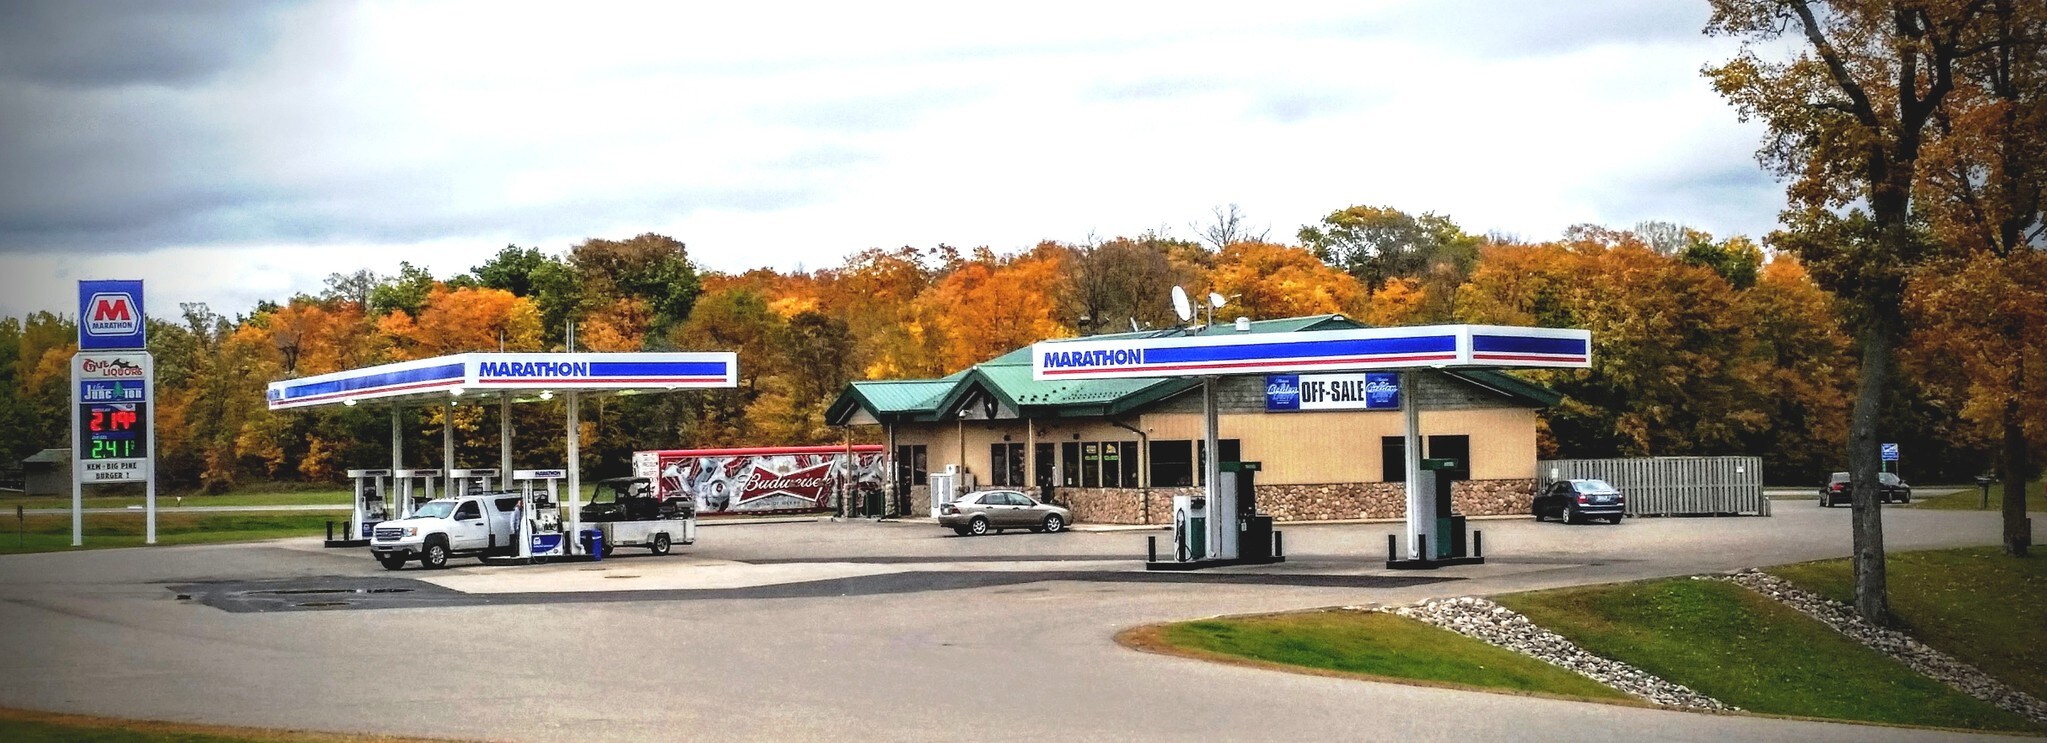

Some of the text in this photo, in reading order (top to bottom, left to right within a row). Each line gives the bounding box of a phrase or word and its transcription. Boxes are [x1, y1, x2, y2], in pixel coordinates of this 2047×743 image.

[94, 299, 131, 321] M
[92, 322, 132, 330] MARATHON
[1043, 348, 1141, 368] MARATHON
[103, 367, 143, 377] LIQUORS
[479, 361, 587, 377] MARATHON
[1301, 380, 1365, 403] OFF-SALE
[95, 472, 123, 480] BURGER
